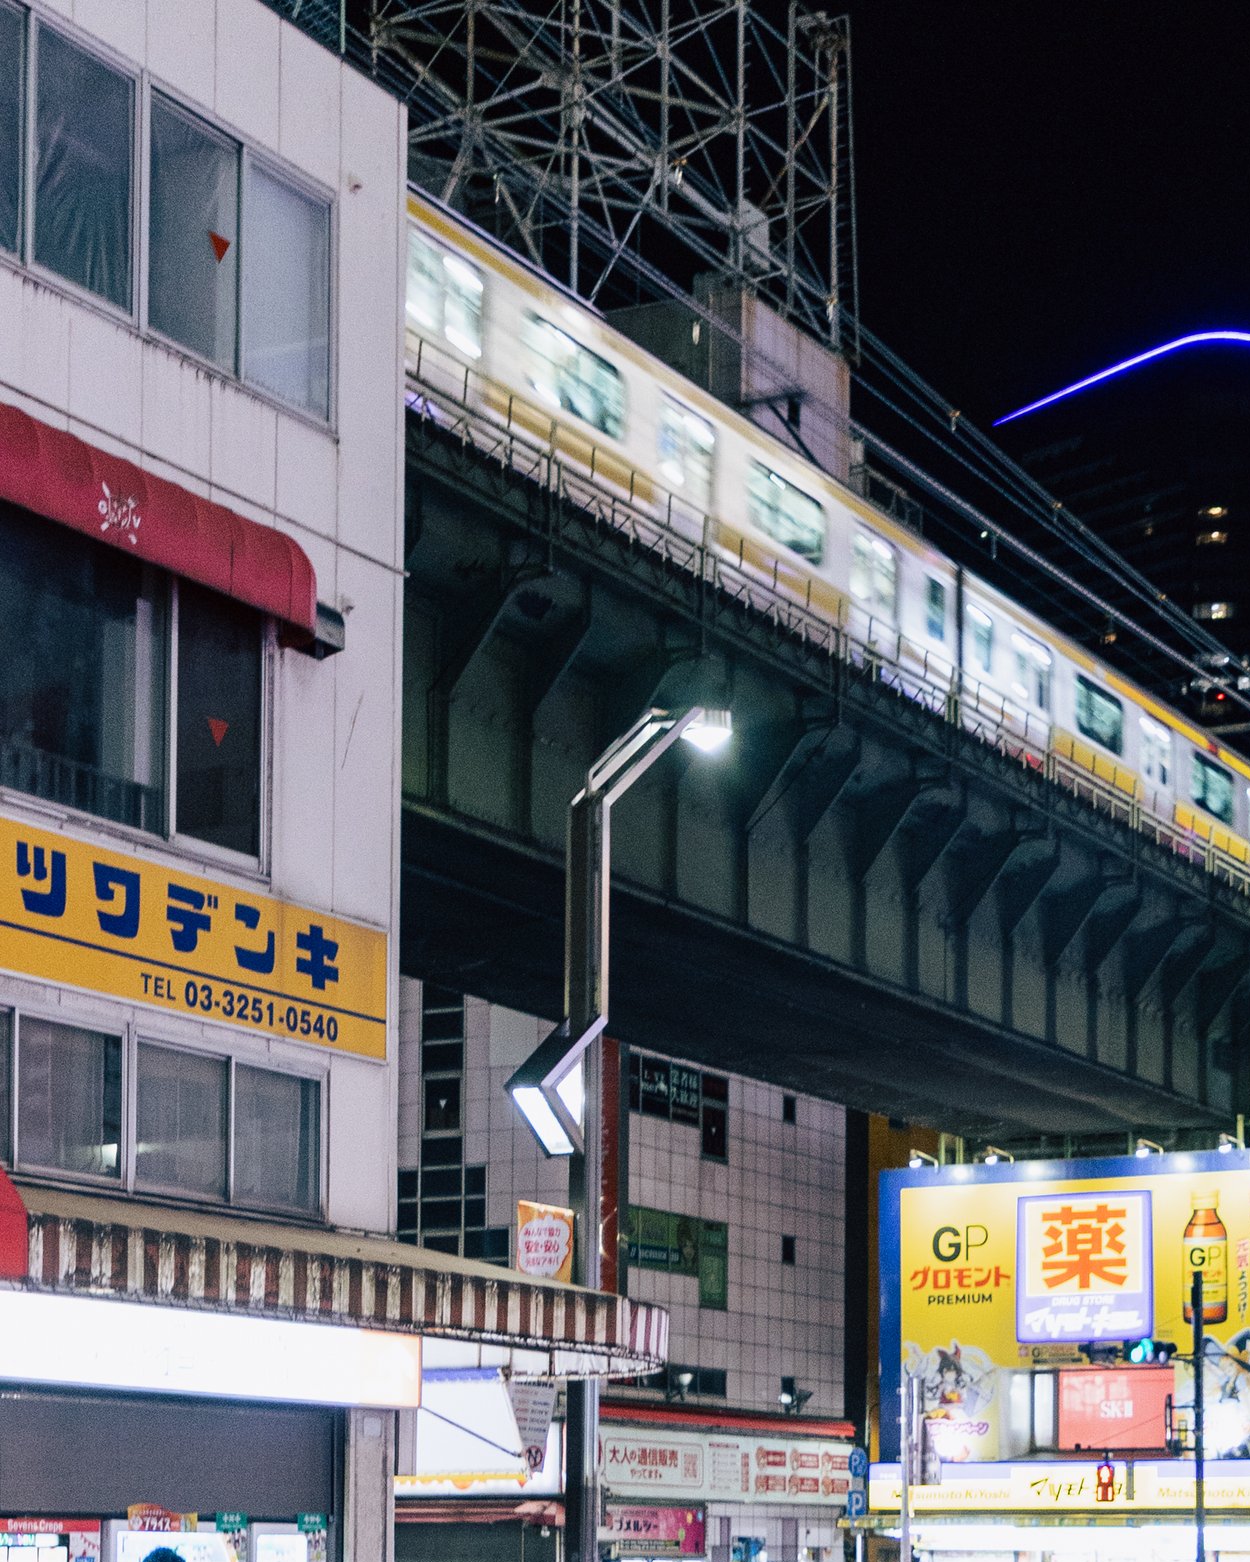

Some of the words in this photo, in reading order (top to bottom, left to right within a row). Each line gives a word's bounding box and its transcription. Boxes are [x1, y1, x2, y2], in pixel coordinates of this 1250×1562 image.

[16, 840, 340, 990] ツワデンキ
[140, 973, 177, 1002] TEL
[185, 980, 339, 1043] 03-3251-0540
[932, 1224, 989, 1263] GP
[1042, 1204, 1129, 1290] 薬
[1189, 1245, 1222, 1267] GP
[910, 1265, 1011, 1291] グロモント
[927, 1294, 993, 1306] PREMIUM
[1051, 1295, 1081, 1307] DRUG
[1082, 1294, 1116, 1306] STORE
